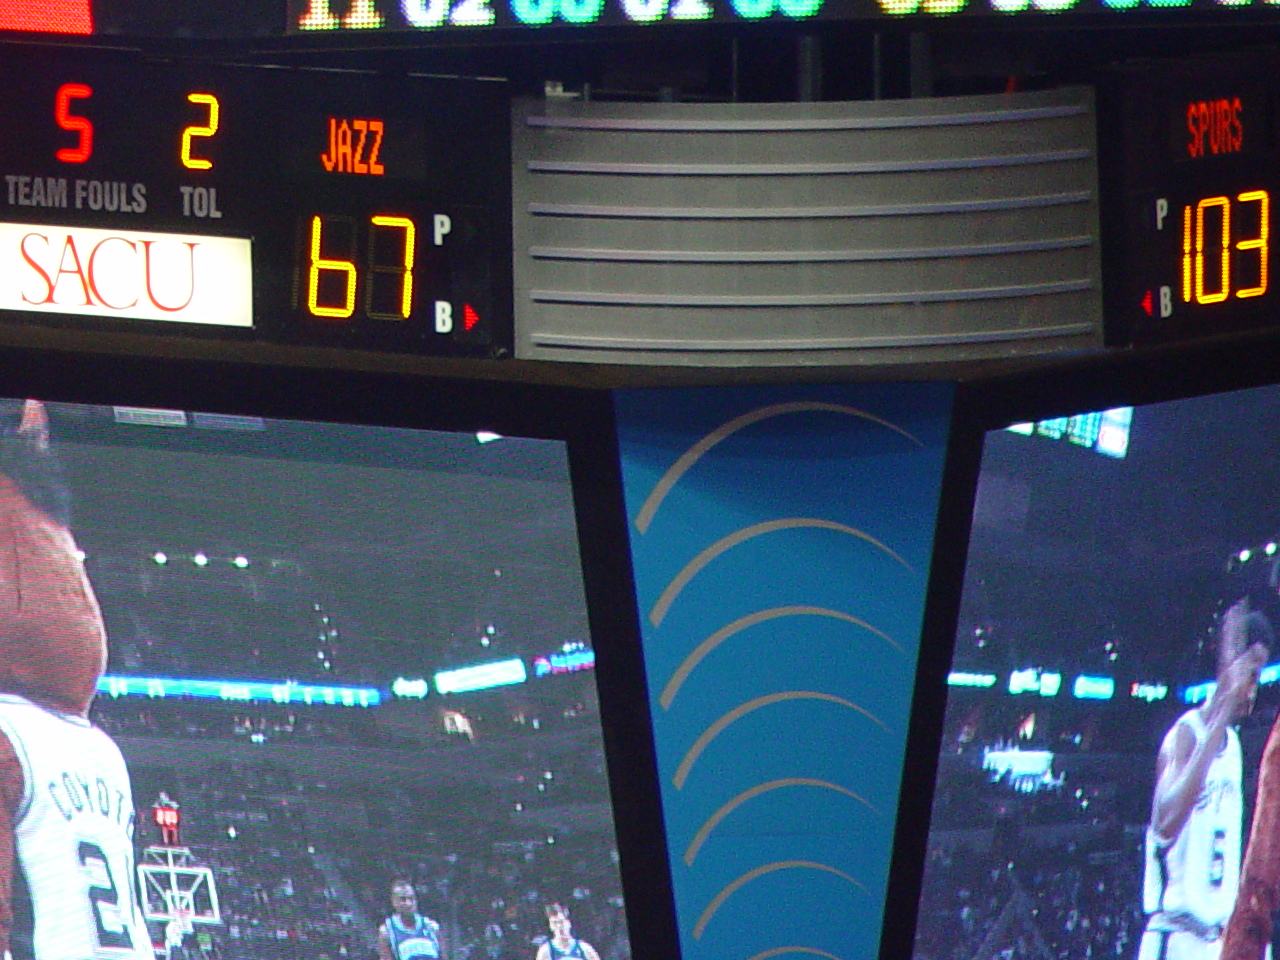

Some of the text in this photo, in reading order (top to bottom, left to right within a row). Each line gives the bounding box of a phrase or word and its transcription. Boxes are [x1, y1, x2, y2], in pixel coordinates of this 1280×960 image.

[55, 83, 93, 164] 5
[181, 93, 219, 169] 2
[322, 117, 384, 175] JAZZ
[1187, 97, 1243, 158] SPURS
[6, 175, 146, 213] TEAM FOULS
[180, 185, 222, 218] TOL
[1156, 198, 1168, 230] P
[434, 214, 451, 246] P
[1183, 190, 1269, 305] 103
[20, 231, 199, 313] SACU
[308, 215, 414, 319] 67
[435, 301, 452, 333] B
[1160, 285, 1171, 318] B
